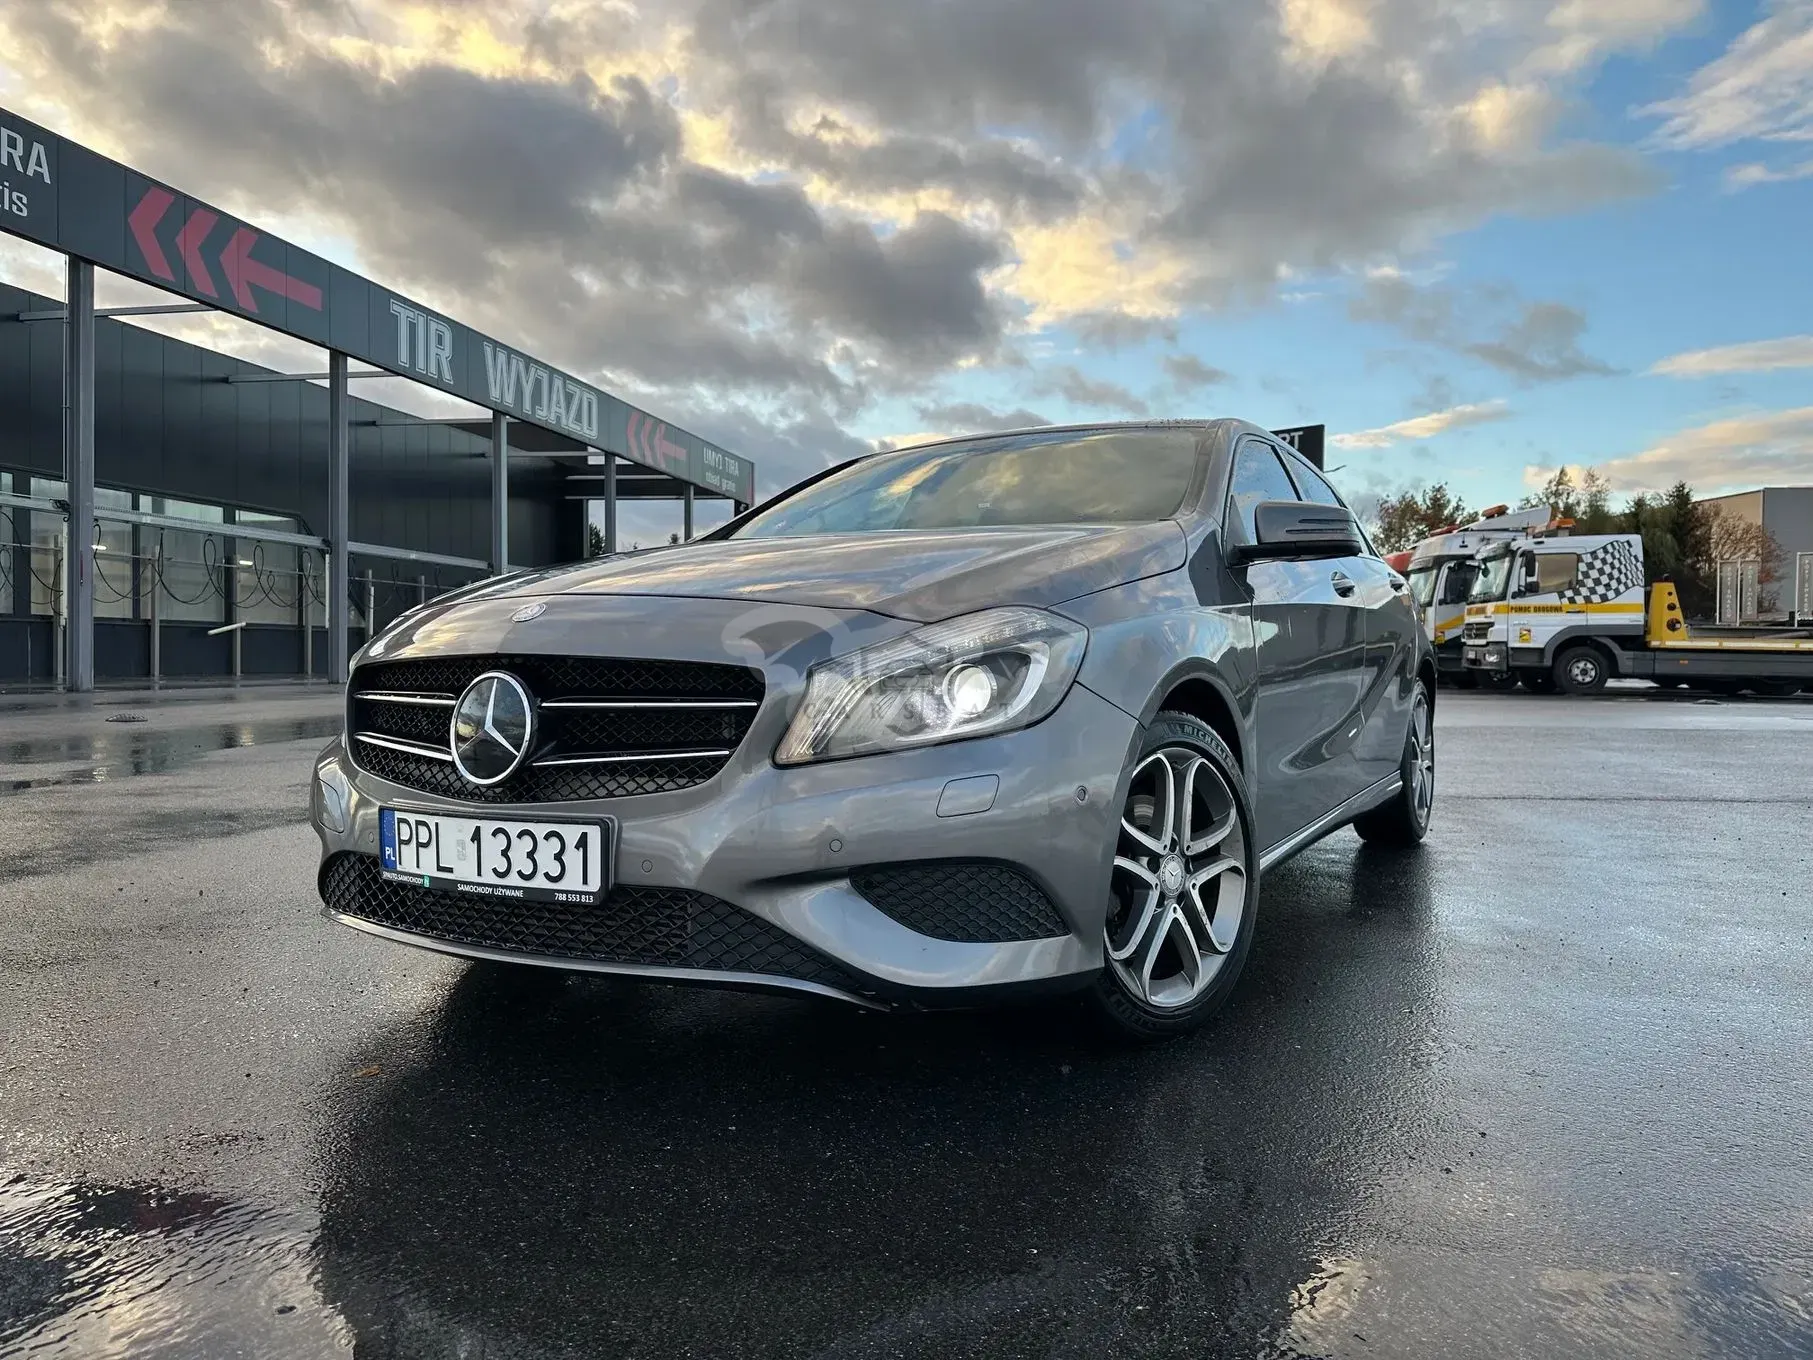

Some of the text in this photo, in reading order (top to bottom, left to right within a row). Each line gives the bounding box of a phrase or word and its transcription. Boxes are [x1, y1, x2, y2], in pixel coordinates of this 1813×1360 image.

[0, 181, 28, 217] is
[390, 298, 598, 440] TIR WYJAZD
[385, 846, 396, 861] PL
[397, 817, 588, 886] PPL 13331
[457, 883, 493, 895] SAMOCHODY
[554, 892, 594, 903] 788 553 813
